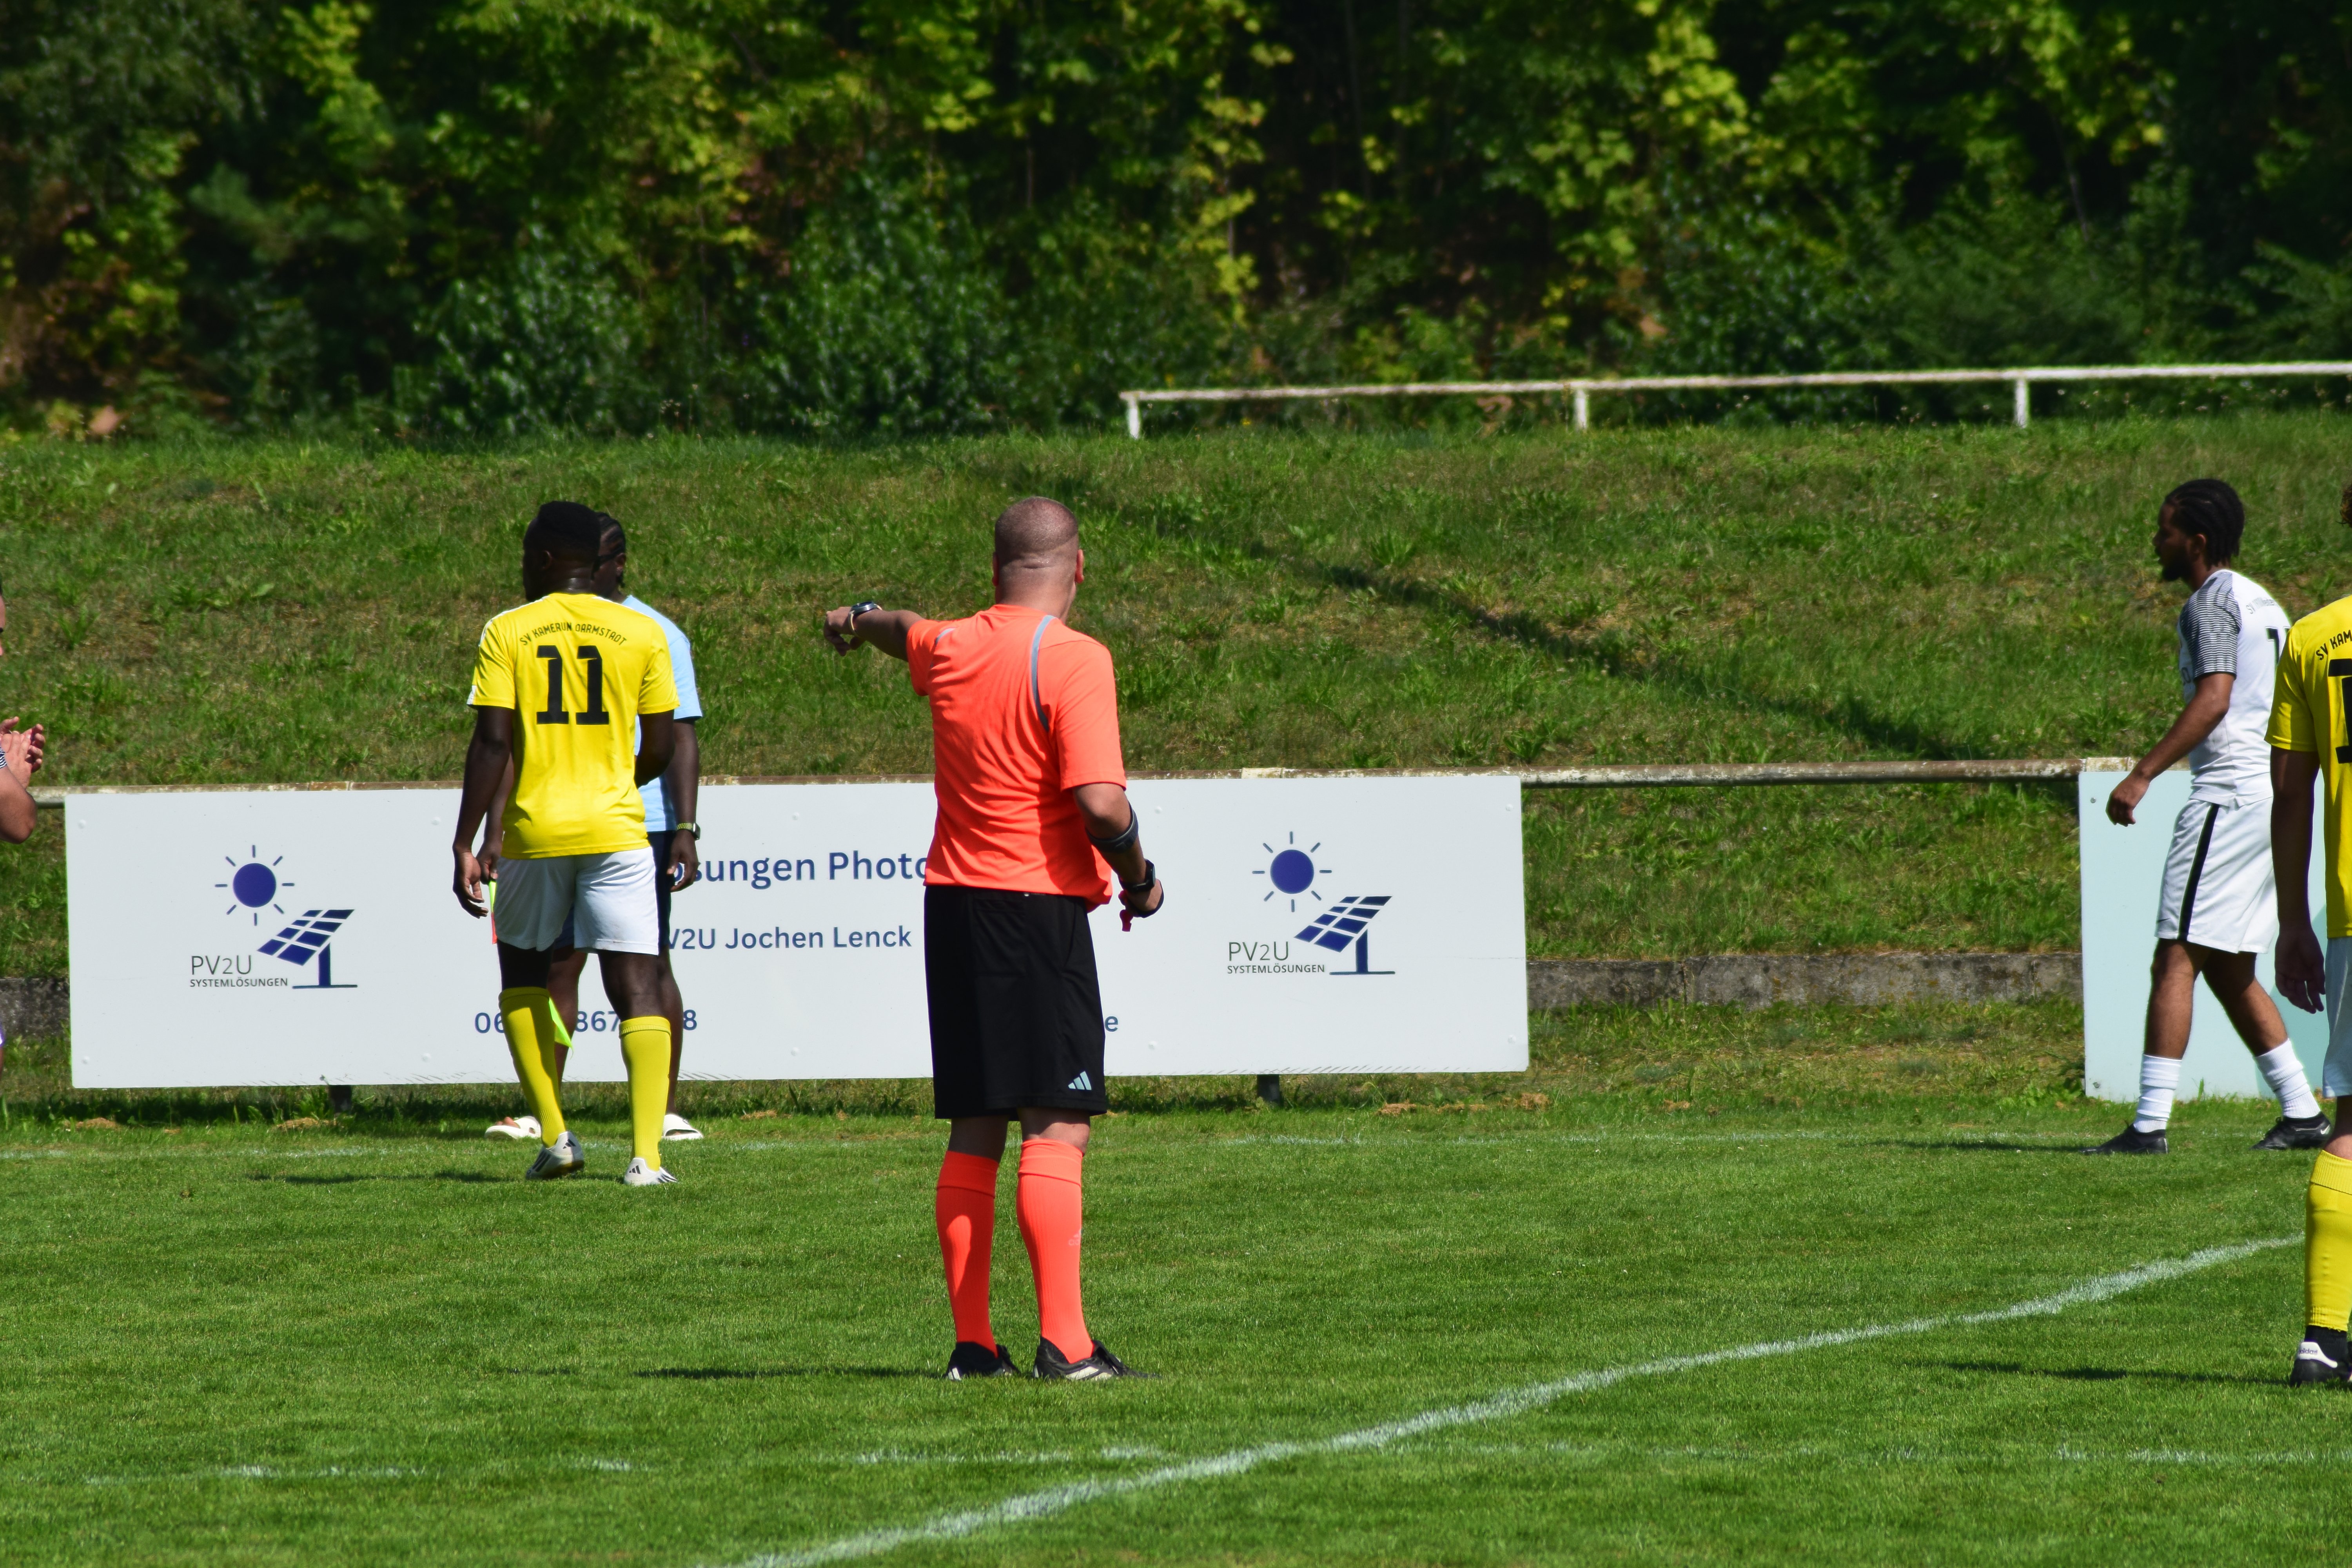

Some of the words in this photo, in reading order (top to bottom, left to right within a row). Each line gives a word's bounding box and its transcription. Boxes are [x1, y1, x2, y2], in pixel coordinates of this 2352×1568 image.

[520, 633, 532, 645] SV
[532, 622, 572, 638] KAMERUN
[575, 624, 627, 645] DARMSTADT
[2316, 643, 2328, 661] SV
[536, 645, 609, 725] 11
[669, 928, 715, 949] V2U
[725, 926, 823, 949] Jochen
[833, 925, 912, 948] Lenck
[1228, 941, 1289, 961] PV2U
[191, 955, 252, 975] PV2U
[1227, 963, 1325, 974] SYSTEMLÖSUNGEN
[189, 977, 288, 987] SYSTEMLÖSUNGEN
